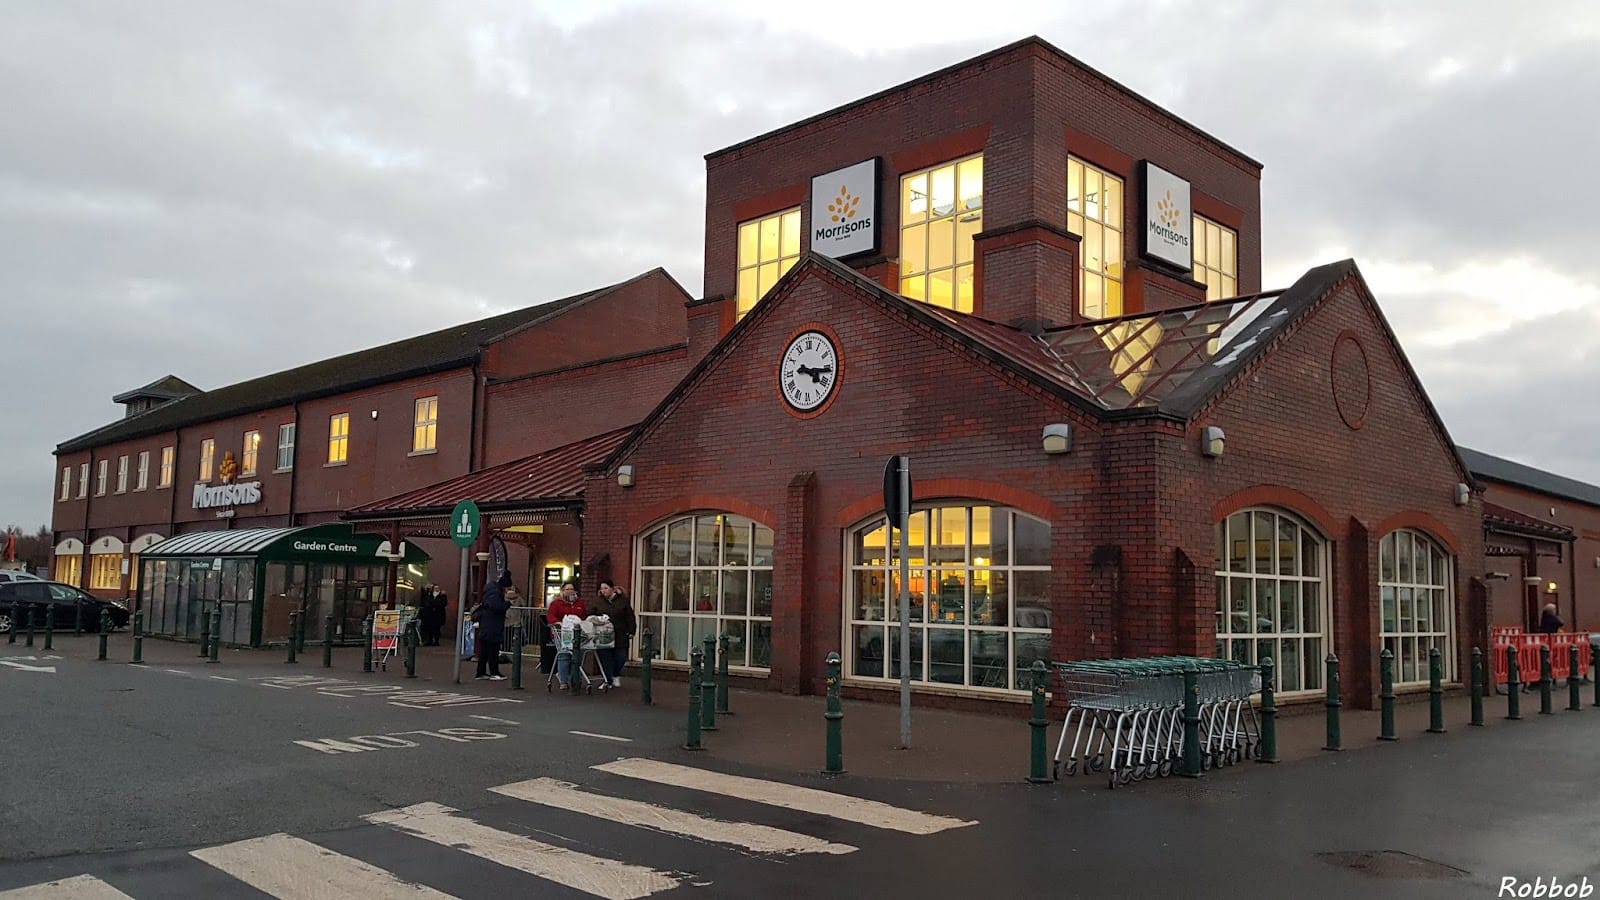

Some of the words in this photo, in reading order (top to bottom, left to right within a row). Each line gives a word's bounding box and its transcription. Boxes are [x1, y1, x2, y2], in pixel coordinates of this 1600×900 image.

[815, 218, 871, 241] Morrisons
[1149, 219, 1188, 246] Morrisons
[192, 481, 262, 509] Morrisons
[293, 540, 327, 551] Garden
[328, 542, 358, 553] Centre
[292, 728, 508, 754] SLOW
